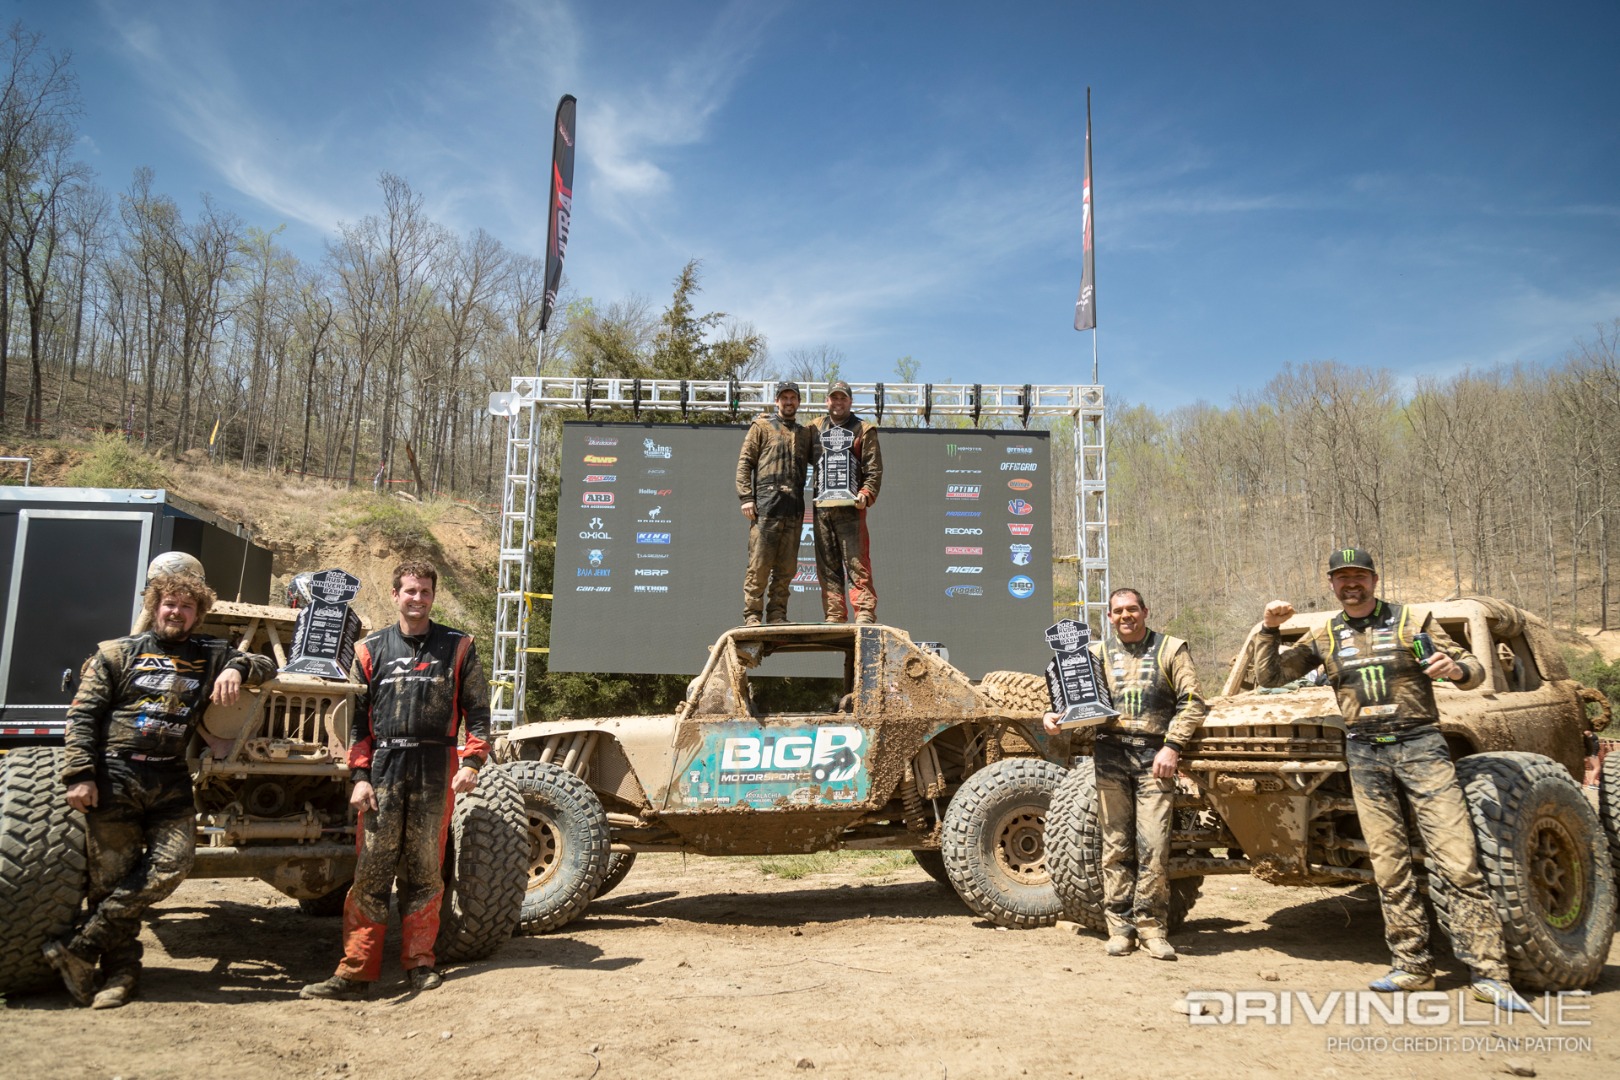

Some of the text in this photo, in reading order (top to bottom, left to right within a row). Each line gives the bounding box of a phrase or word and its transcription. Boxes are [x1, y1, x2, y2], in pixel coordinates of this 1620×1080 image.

[638, 488, 658, 496] Holley
[948, 485, 980, 493] OPTIMA
[586, 493, 611, 502] ARB
[577, 568, 611, 577] BAJA JERKY
[945, 566, 983, 574] RIGID
[327, 571, 347, 579] 2022
[310, 580, 362, 591] ANNIVERSARY
[323, 588, 344, 596] BASH
[1058, 626, 1078, 634] RUSH
[1045, 629, 1091, 642] ANNIVERSARY
[1060, 637, 1079, 645] BASH
[720, 771, 812, 783] MOTORSPORTS
